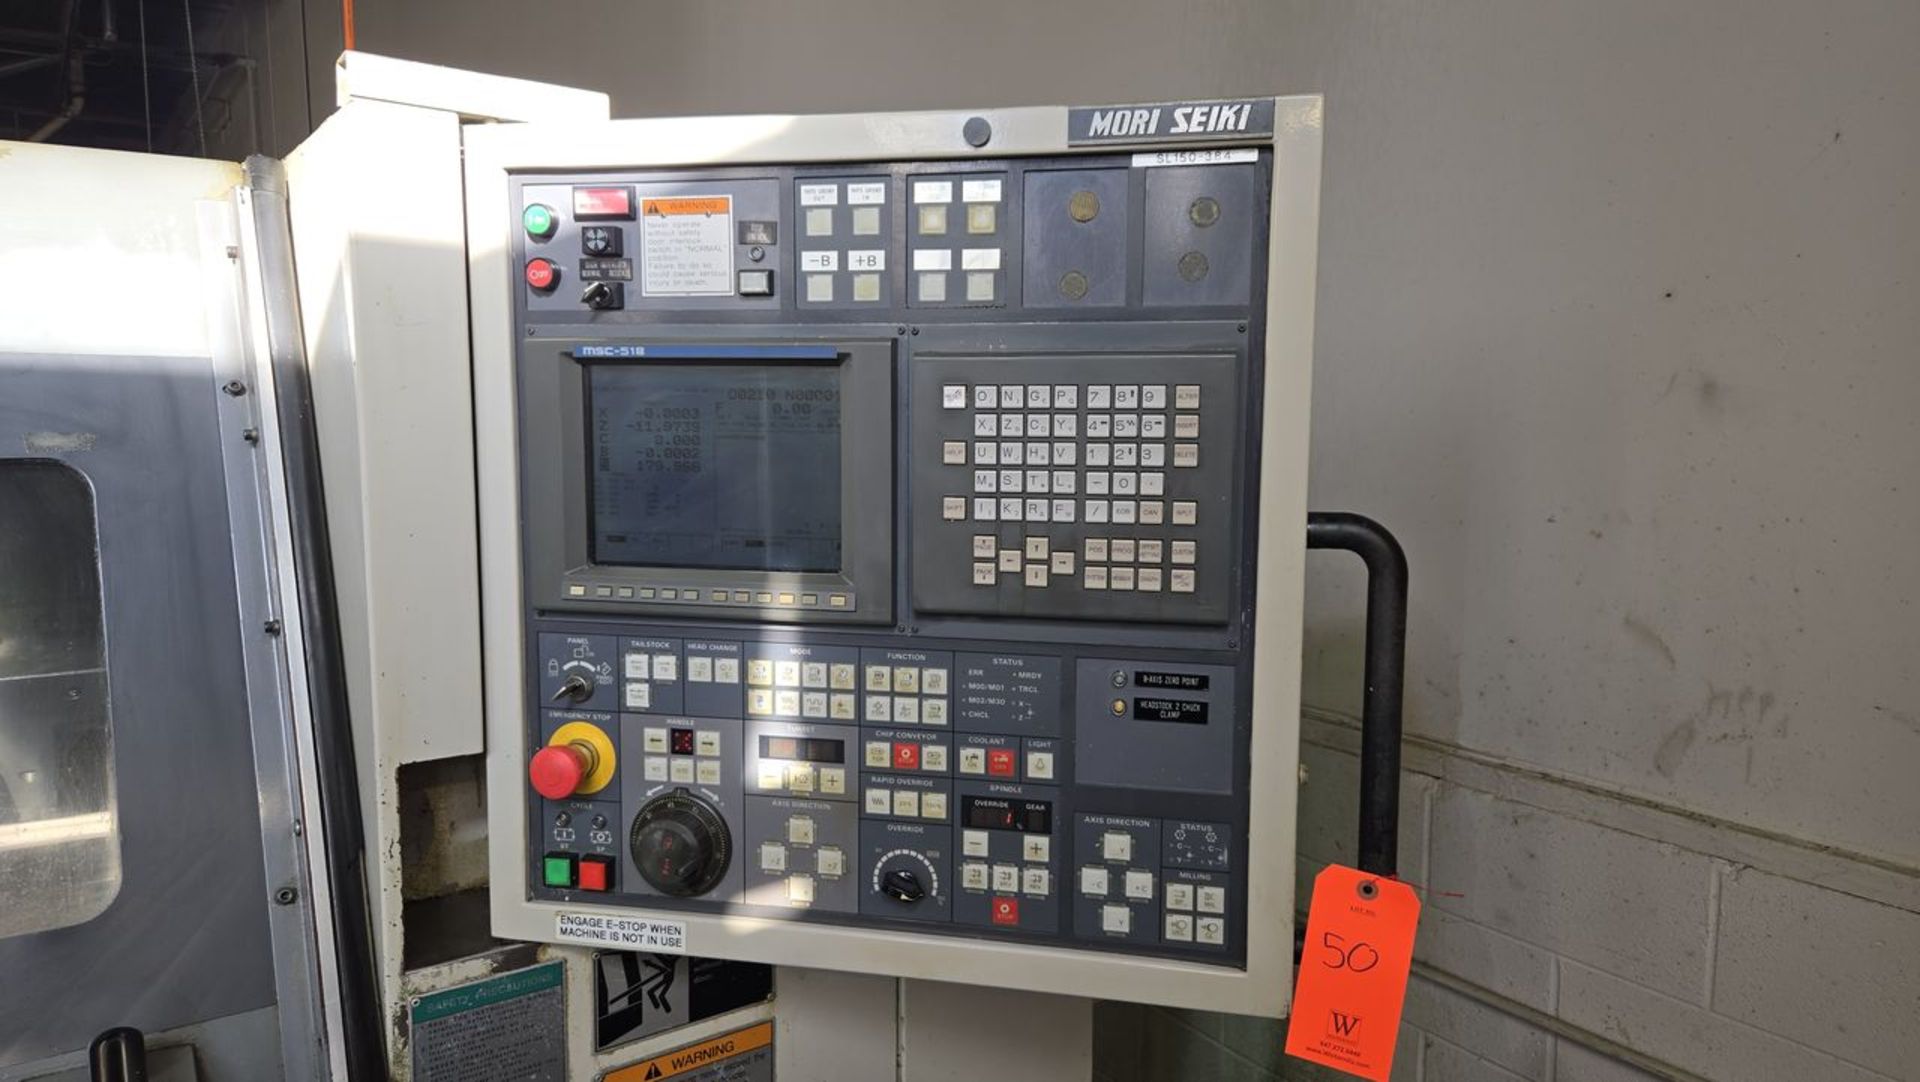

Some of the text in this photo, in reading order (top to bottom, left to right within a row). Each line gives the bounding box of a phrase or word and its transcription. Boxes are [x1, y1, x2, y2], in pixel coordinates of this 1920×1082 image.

[1088, 104, 1252, 137] MORI SEIKI
[670, 201, 717, 209] WARNING
[856, 255, 877, 266] +B
[1004, 391, 1013, 400] N
[1030, 391, 1040, 401] G
[1057, 391, 1066, 400] P
[1090, 391, 1099, 402] 7
[1117, 391, 1126, 402] 8
[1144, 391, 1154, 402] 9
[978, 420, 986, 429] X
[1004, 419, 1012, 429] Z
[1030, 420, 1039, 430] C
[1057, 419, 1066, 429] Y
[1088, 421, 1097, 431] 4
[1116, 420, 1125, 431] 5
[1144, 420, 1152, 431] 6
[977, 448, 986, 457] U
[1003, 448, 1013, 457] W
[1029, 448, 1038, 457] H
[1056, 448, 1065, 457] V
[1089, 449, 1095, 459] 1
[1115, 449, 1124, 460] 2
[1142, 449, 1152, 460] 3
[977, 475, 987, 485] M
[1003, 475, 1012, 485] S
[1030, 475, 1039, 485] T
[1056, 476, 1064, 487] L
[1003, 503, 1011, 513] K
[1029, 504, 1038, 513] R
[1055, 504, 1063, 514] F
[631, 640, 670, 648] TAILSTOCK
[789, 648, 811, 656] MODE
[887, 652, 927, 661] FUNCTION
[992, 658, 1024, 666] STATUS
[1165, 677, 1180, 685] ZERO
[1181, 678, 1200, 686] POINT
[1140, 701, 1173, 710] HEADSTOCK
[1181, 703, 1201, 712] CHUCK
[1160, 711, 1181, 719] CLAMP
[666, 718, 695, 726] HANDLE
[875, 730, 937, 740] CHIP CONVEYOR
[968, 737, 1006, 745] COOLANT
[1028, 740, 1052, 748] LIGHT
[871, 777, 934, 787] RAPID OVERRIDE
[989, 785, 1022, 794] SPINDLE
[570, 802, 593, 810] CYCLE
[974, 799, 1045, 811] OVERRIDE GEAR
[1084, 816, 1150, 828] AXIS DIRECTION
[887, 824, 924, 833] OVERRIDE
[1180, 823, 1213, 832] STATUS
[1180, 872, 1211, 881] MILLING
[560, 915, 682, 935] ENGAGE E-STOP WHEN
[560, 927, 682, 948] MACHINE IS NOT IN USE
[1322, 932, 1379, 973] 50
[1331, 1010, 1360, 1037] W
[671, 1041, 735, 1071] WARNING
